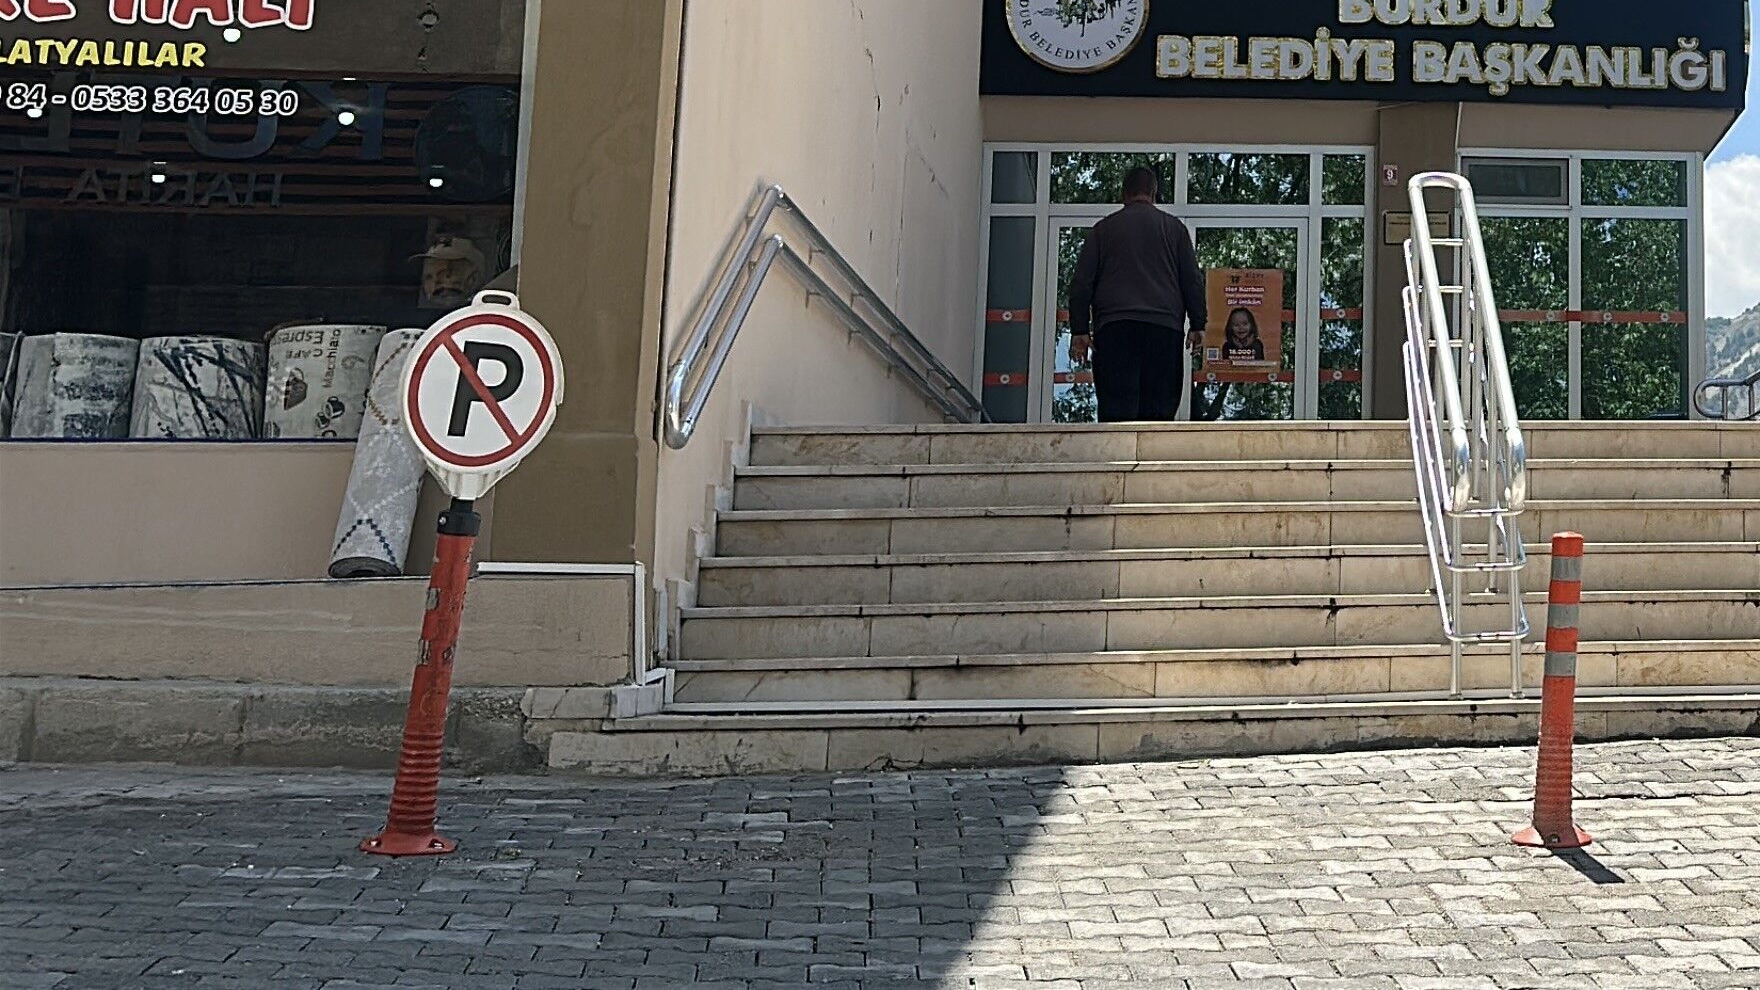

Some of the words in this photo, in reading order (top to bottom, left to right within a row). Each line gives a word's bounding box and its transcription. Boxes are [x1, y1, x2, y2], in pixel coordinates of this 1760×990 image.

[0, 38, 207, 67] ATYALILAR
[1156, 26, 1394, 81] BELEDİYE
[1412, 37, 1726, 96] BAŞKANLIĞI
[5, 82, 47, 110] 84
[71, 84, 147, 113] 0533
[152, 87, 209, 113] 364
[214, 88, 253, 114] 05
[258, 89, 299, 116] 30
[448, 341, 524, 437] P
